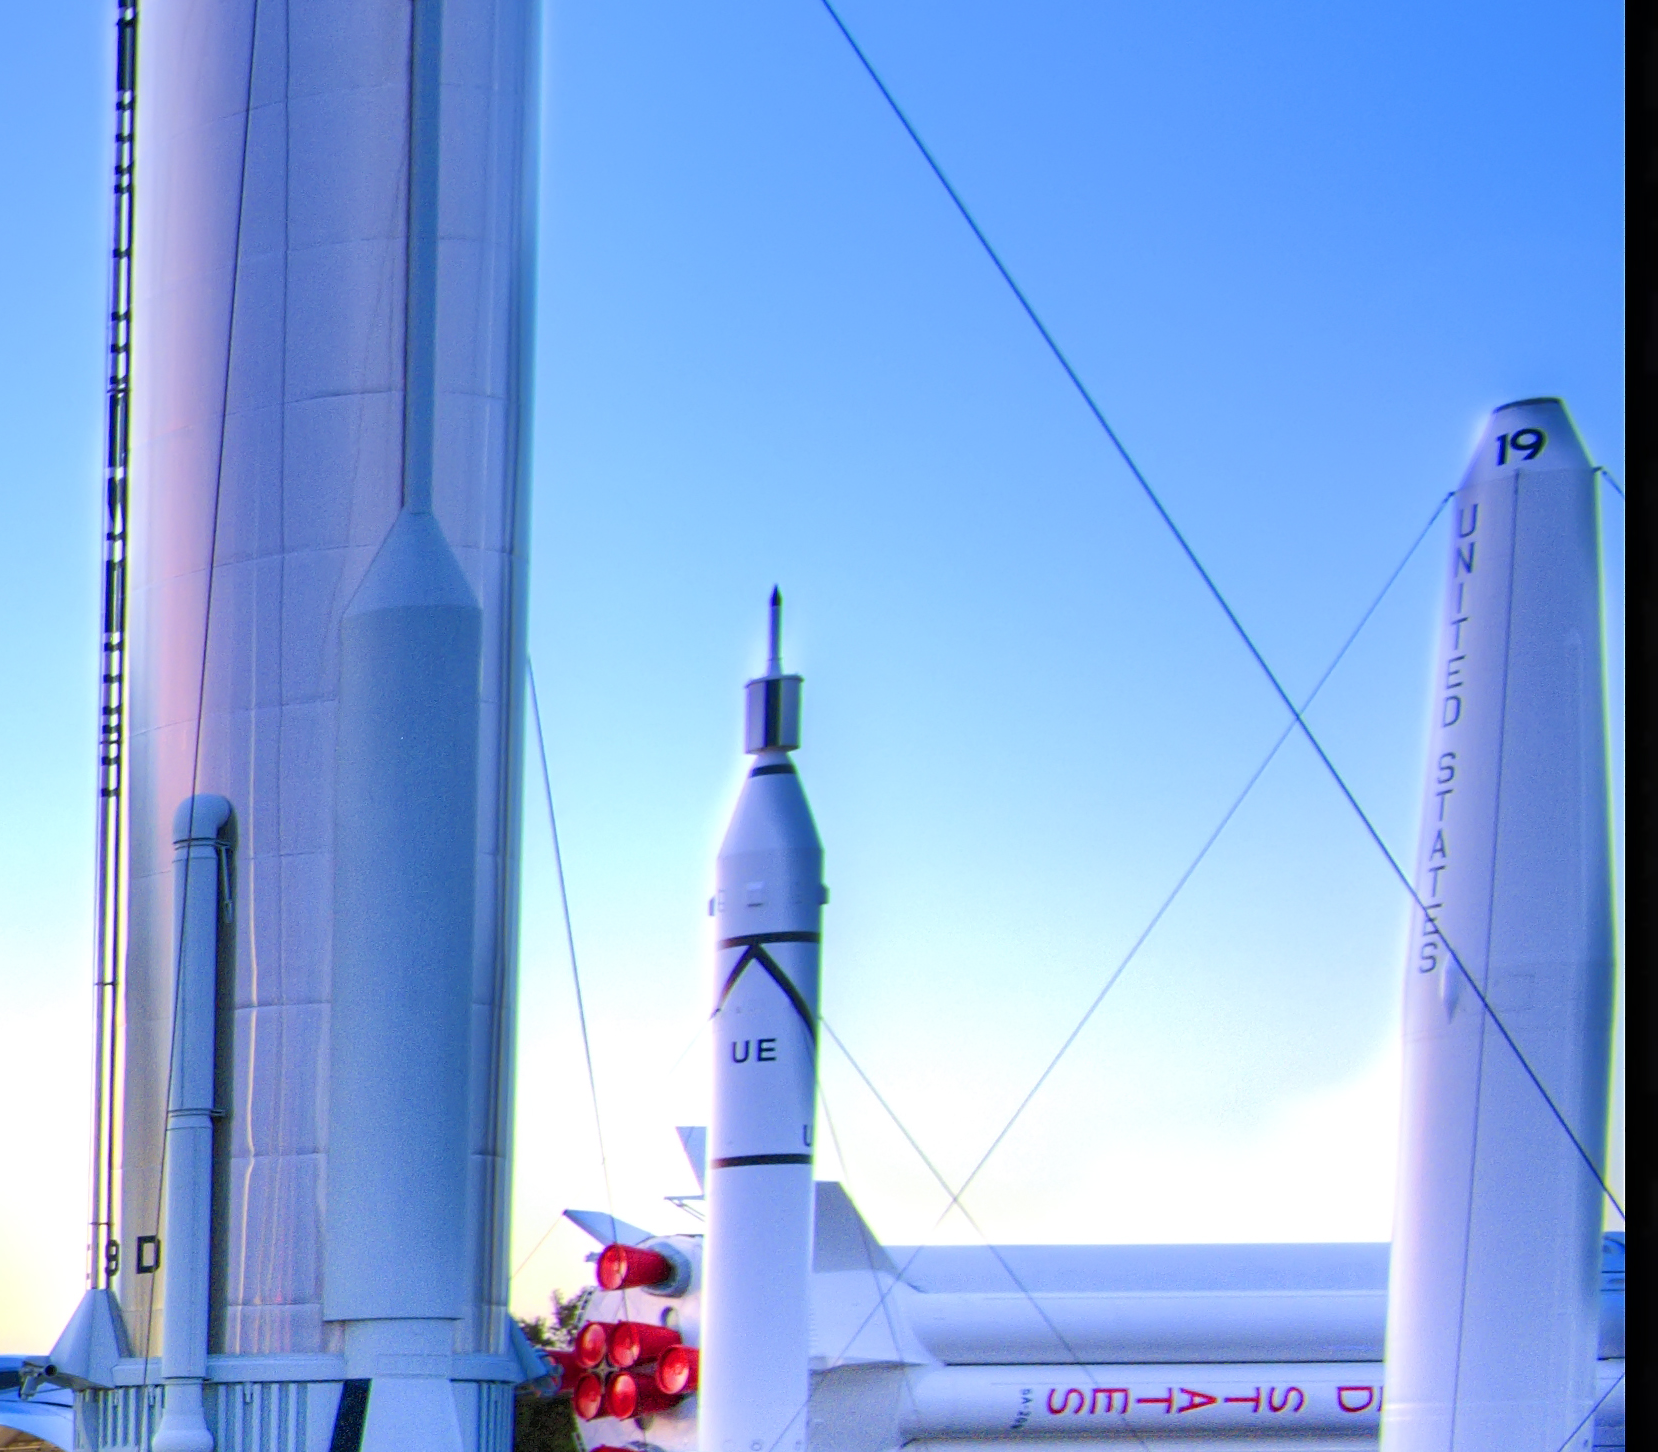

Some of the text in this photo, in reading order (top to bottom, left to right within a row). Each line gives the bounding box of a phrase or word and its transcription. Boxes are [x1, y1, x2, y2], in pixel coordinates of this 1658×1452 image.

[1495, 427, 1548, 467] 19
[1418, 503, 1479, 975] UNITED STATES
[732, 1038, 778, 1063] UE
[1046, 1385, 1307, 1417] STATES
